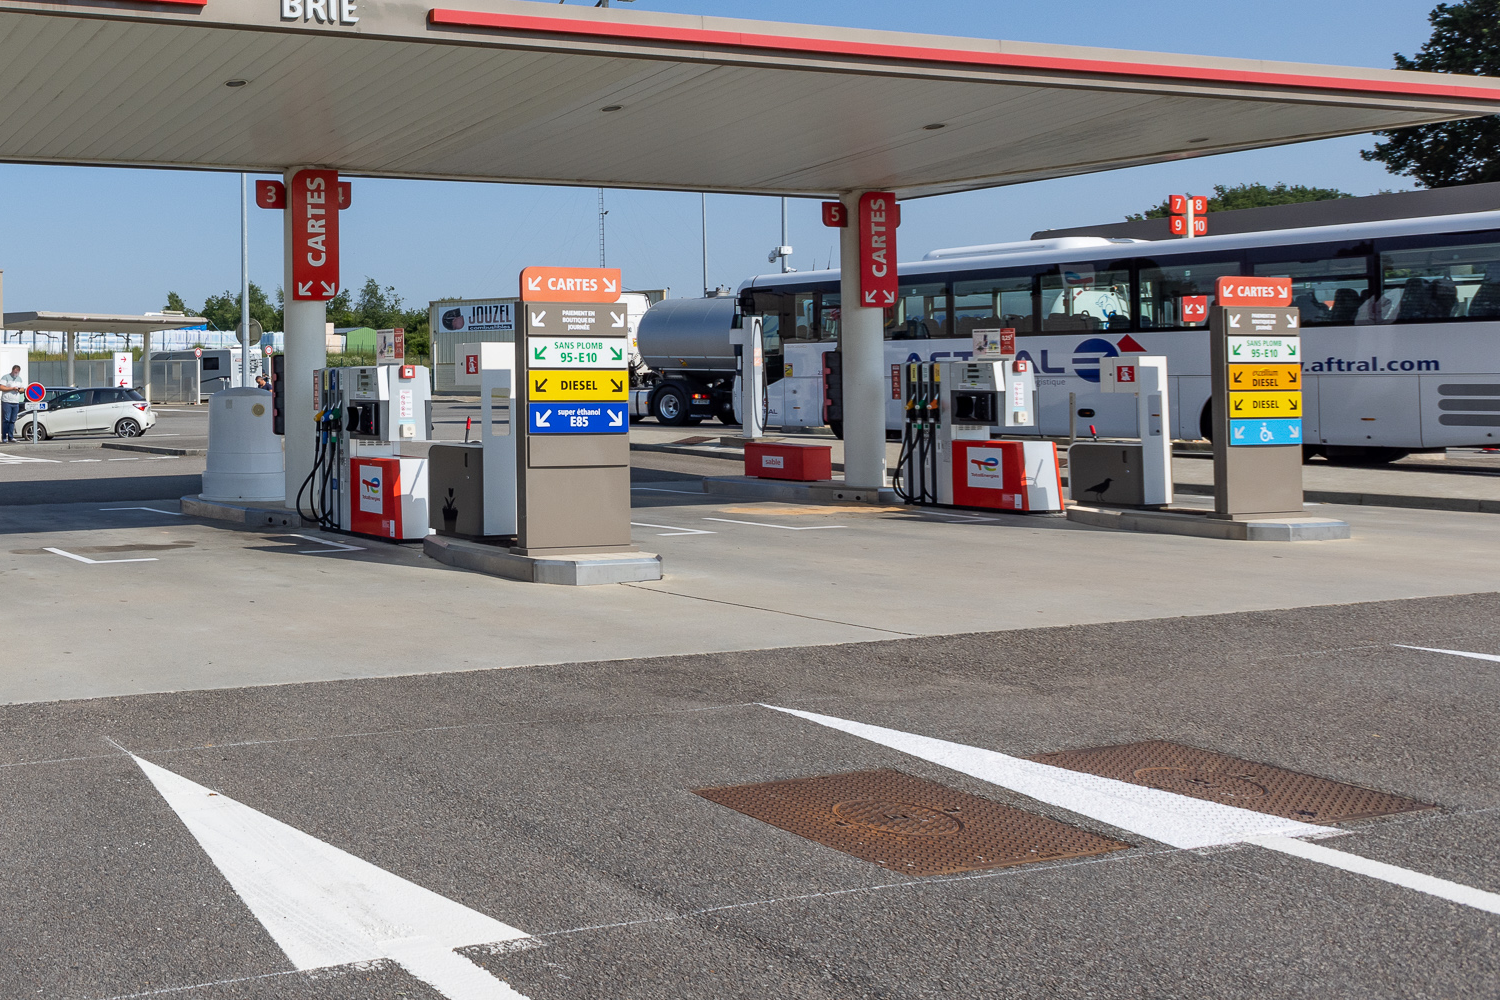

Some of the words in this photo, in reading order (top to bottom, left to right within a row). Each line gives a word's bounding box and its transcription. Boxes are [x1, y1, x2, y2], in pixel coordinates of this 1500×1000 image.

[266, 185, 277, 203] 3
[1175, 198, 1182, 210] 7
[1195, 199, 1202, 211] 8
[831, 206, 840, 222] 5
[306, 177, 327, 267] CARTES
[1175, 219, 1182, 231] 9
[1194, 220, 1205, 232] 10
[870, 198, 888, 278] CARTES
[547, 277, 598, 291] CARTES
[1237, 286, 1274, 297] CARTES
[468, 305, 511, 324] JOUZEL
[568, 323, 590, 331] JOURNÉE
[576, 342, 603, 350] PLOMB
[560, 352, 597, 363] 95-E10
[1251, 349, 1278, 358] 95-E10
[560, 380, 598, 391] DIESEL
[1035, 378, 1066, 387] gistique
[1252, 379, 1278, 387] DIESEL
[1253, 400, 1279, 409] DIESEL
[577, 408, 601, 416] éthanol
[570, 416, 589, 427] E85
[765, 458, 781, 466] sable
